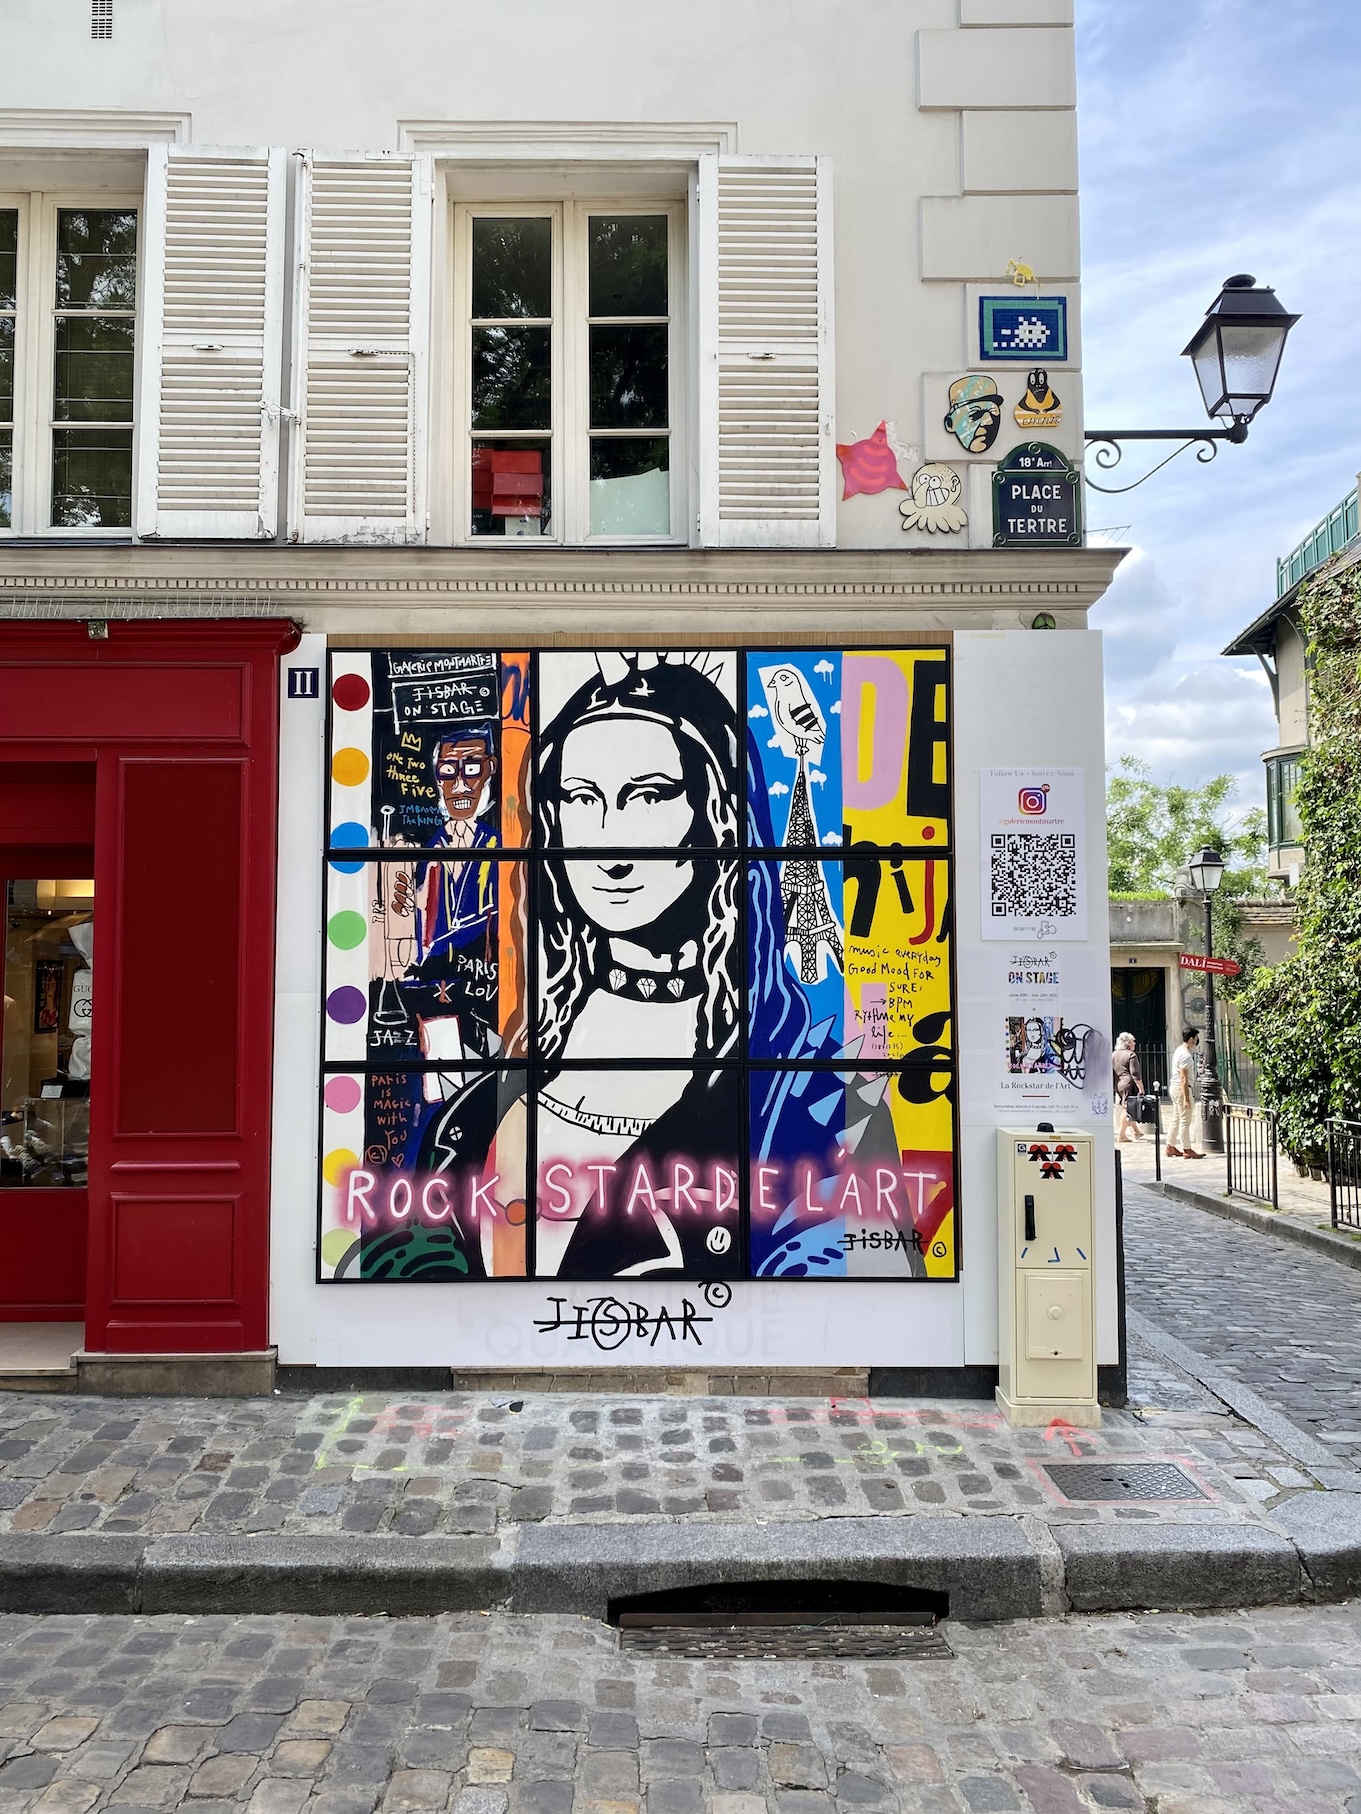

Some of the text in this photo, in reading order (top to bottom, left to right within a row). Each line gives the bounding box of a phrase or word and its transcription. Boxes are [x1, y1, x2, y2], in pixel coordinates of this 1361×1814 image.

[1012, 485, 1061, 499] PLACE
[1031, 505, 1043, 513] DU
[1008, 519, 1067, 533] TERTRE
[404, 700, 484, 717] ON STAGE
[457, 955, 498, 980] PARIS
[1180, 956, 1206, 968] DALÍ
[848, 963, 876, 975] Good
[881, 962, 910, 980] Mood
[1009, 972, 1059, 983] ON STAGE
[370, 1029, 417, 1046] JAZZ
[1011, 1081, 1043, 1089] Rockstar
[1045, 1081, 1054, 1089] de
[347, 1169, 500, 1221] ROCK
[545, 1163, 698, 1214] STAR
[715, 1166, 779, 1212] DE
